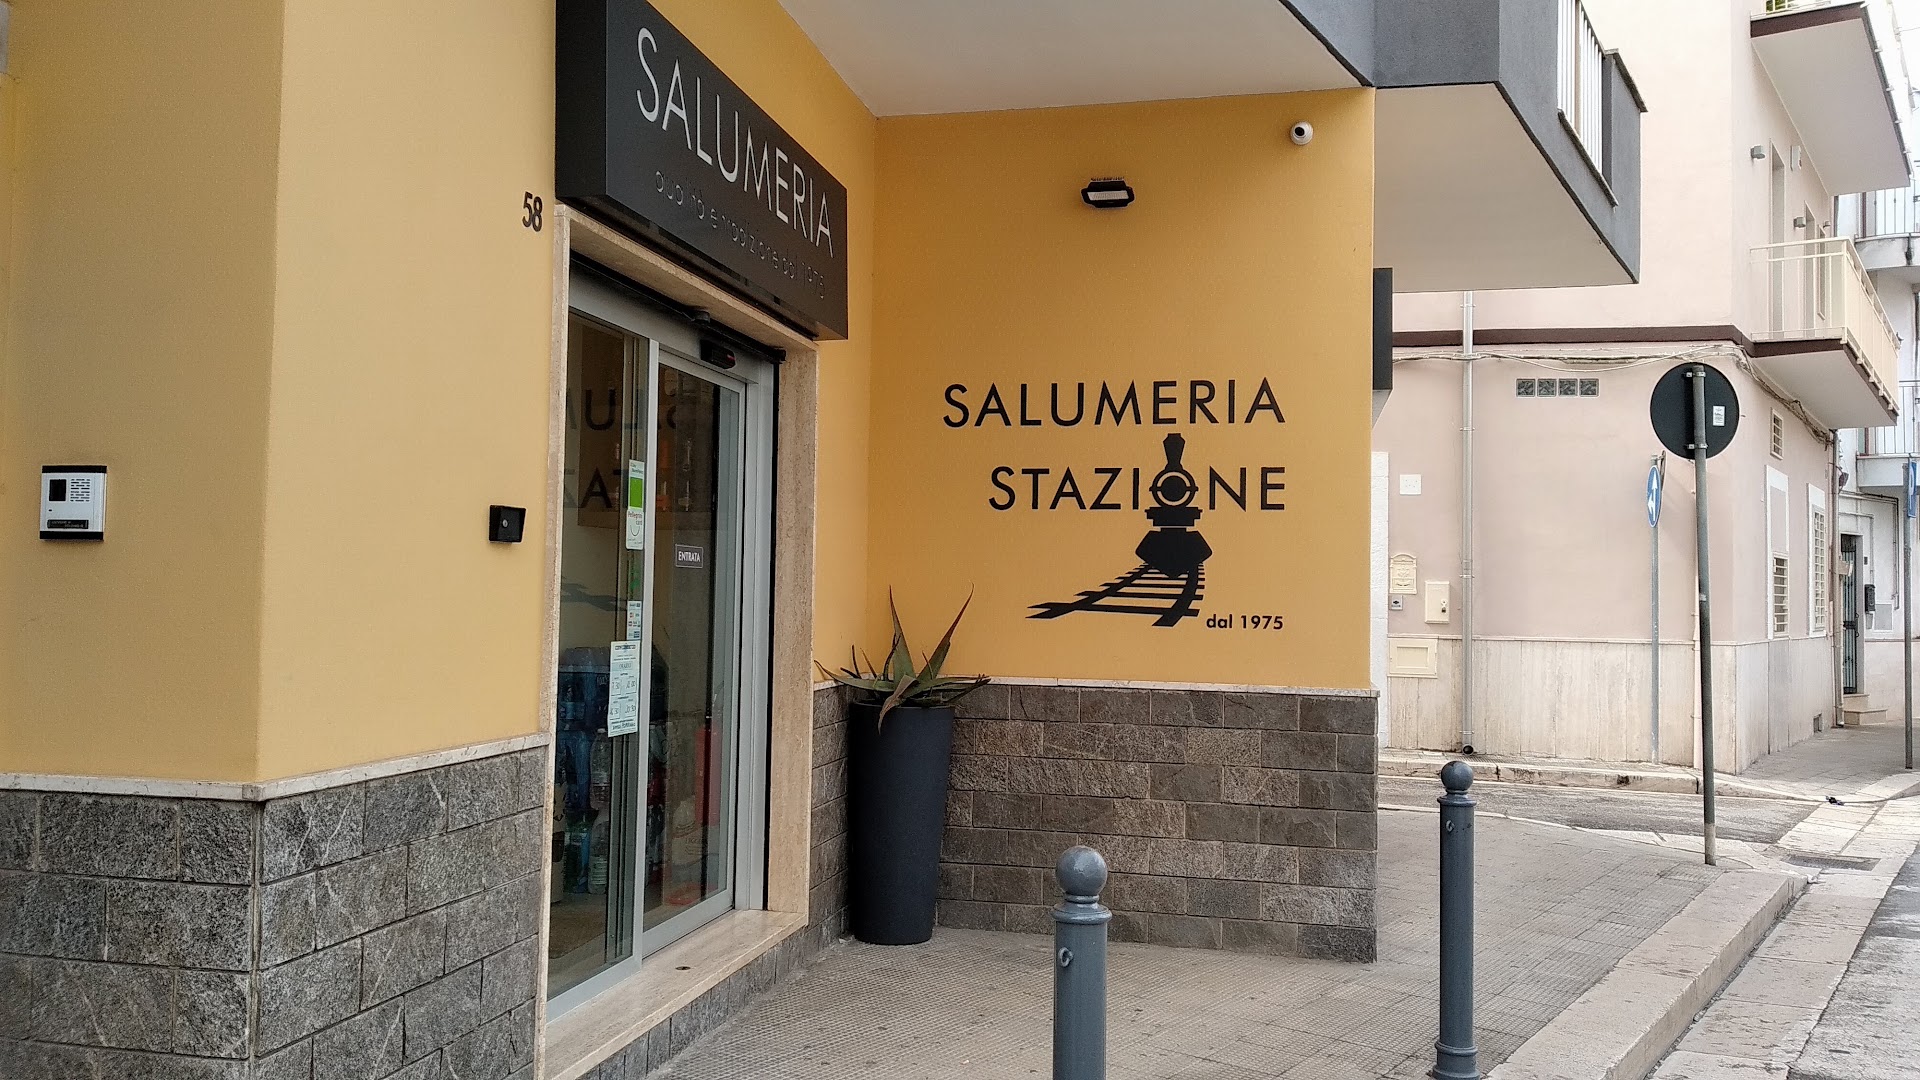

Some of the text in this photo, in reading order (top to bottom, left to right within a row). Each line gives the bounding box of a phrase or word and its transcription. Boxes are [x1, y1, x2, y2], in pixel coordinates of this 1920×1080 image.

[636, 27, 834, 259] SALUMERIA
[522, 191, 543, 232] 58
[943, 377, 1286, 428] SALUMERIA
[988, 465, 1286, 512] STAZIONE
[678, 550, 701, 563] ENTRATA
[1206, 613, 1284, 630] dal 1975
